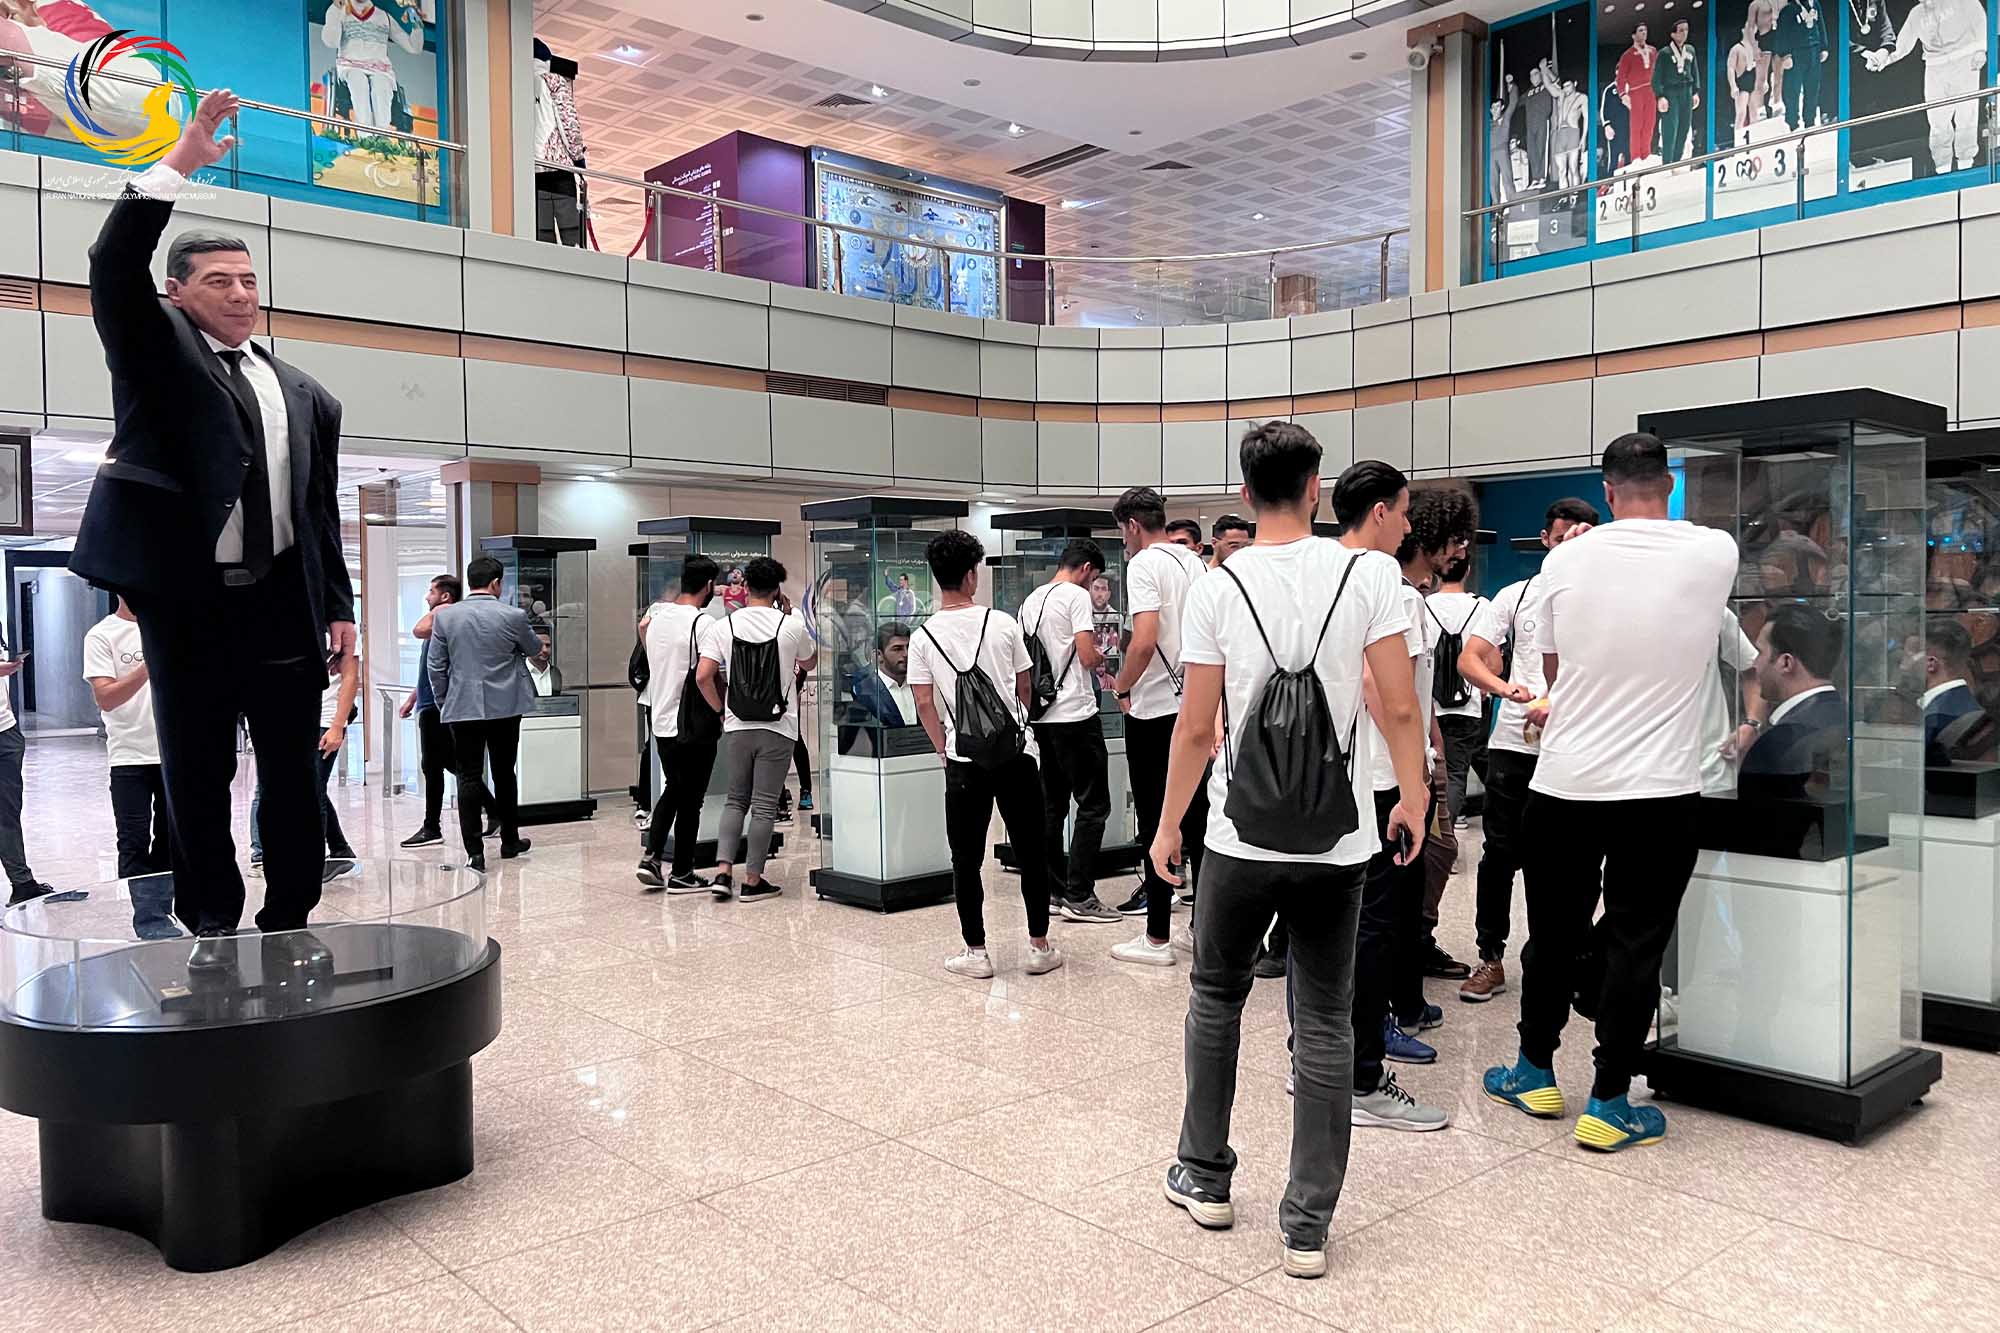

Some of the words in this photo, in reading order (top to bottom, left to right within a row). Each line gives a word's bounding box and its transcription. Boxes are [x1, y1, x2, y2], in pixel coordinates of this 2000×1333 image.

[1718, 164, 1726, 187] 2
[1774, 148, 1786, 177] 3
[1600, 200, 1608, 221] 2
[1646, 186, 1657, 211] 3
[1549, 219, 1559, 235] 3
